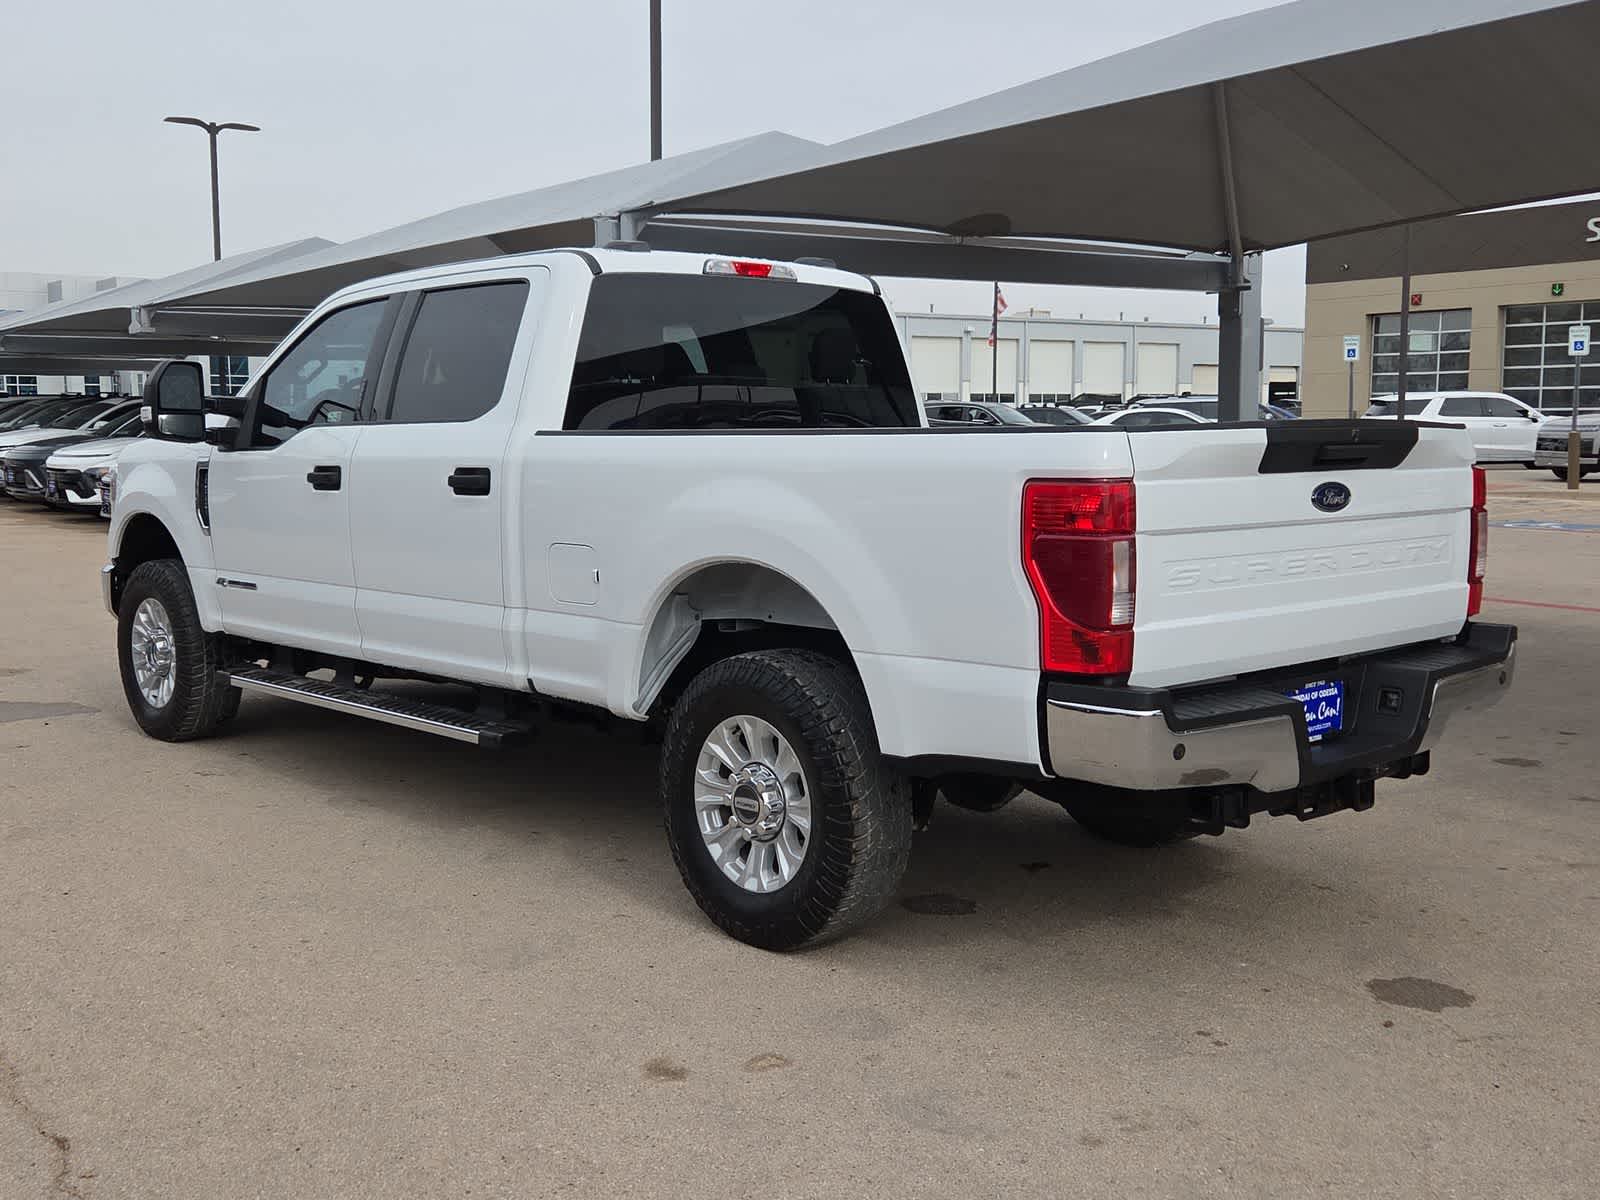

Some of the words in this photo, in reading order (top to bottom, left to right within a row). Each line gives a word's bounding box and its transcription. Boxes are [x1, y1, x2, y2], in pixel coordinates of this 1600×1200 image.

[1166, 553, 1338, 588] SUPER
[1350, 538, 1449, 569] DUTY
[1311, 691, 1318, 699] OF
[1319, 687, 1338, 698] ODESSA
[1318, 697, 1340, 720] Can!
